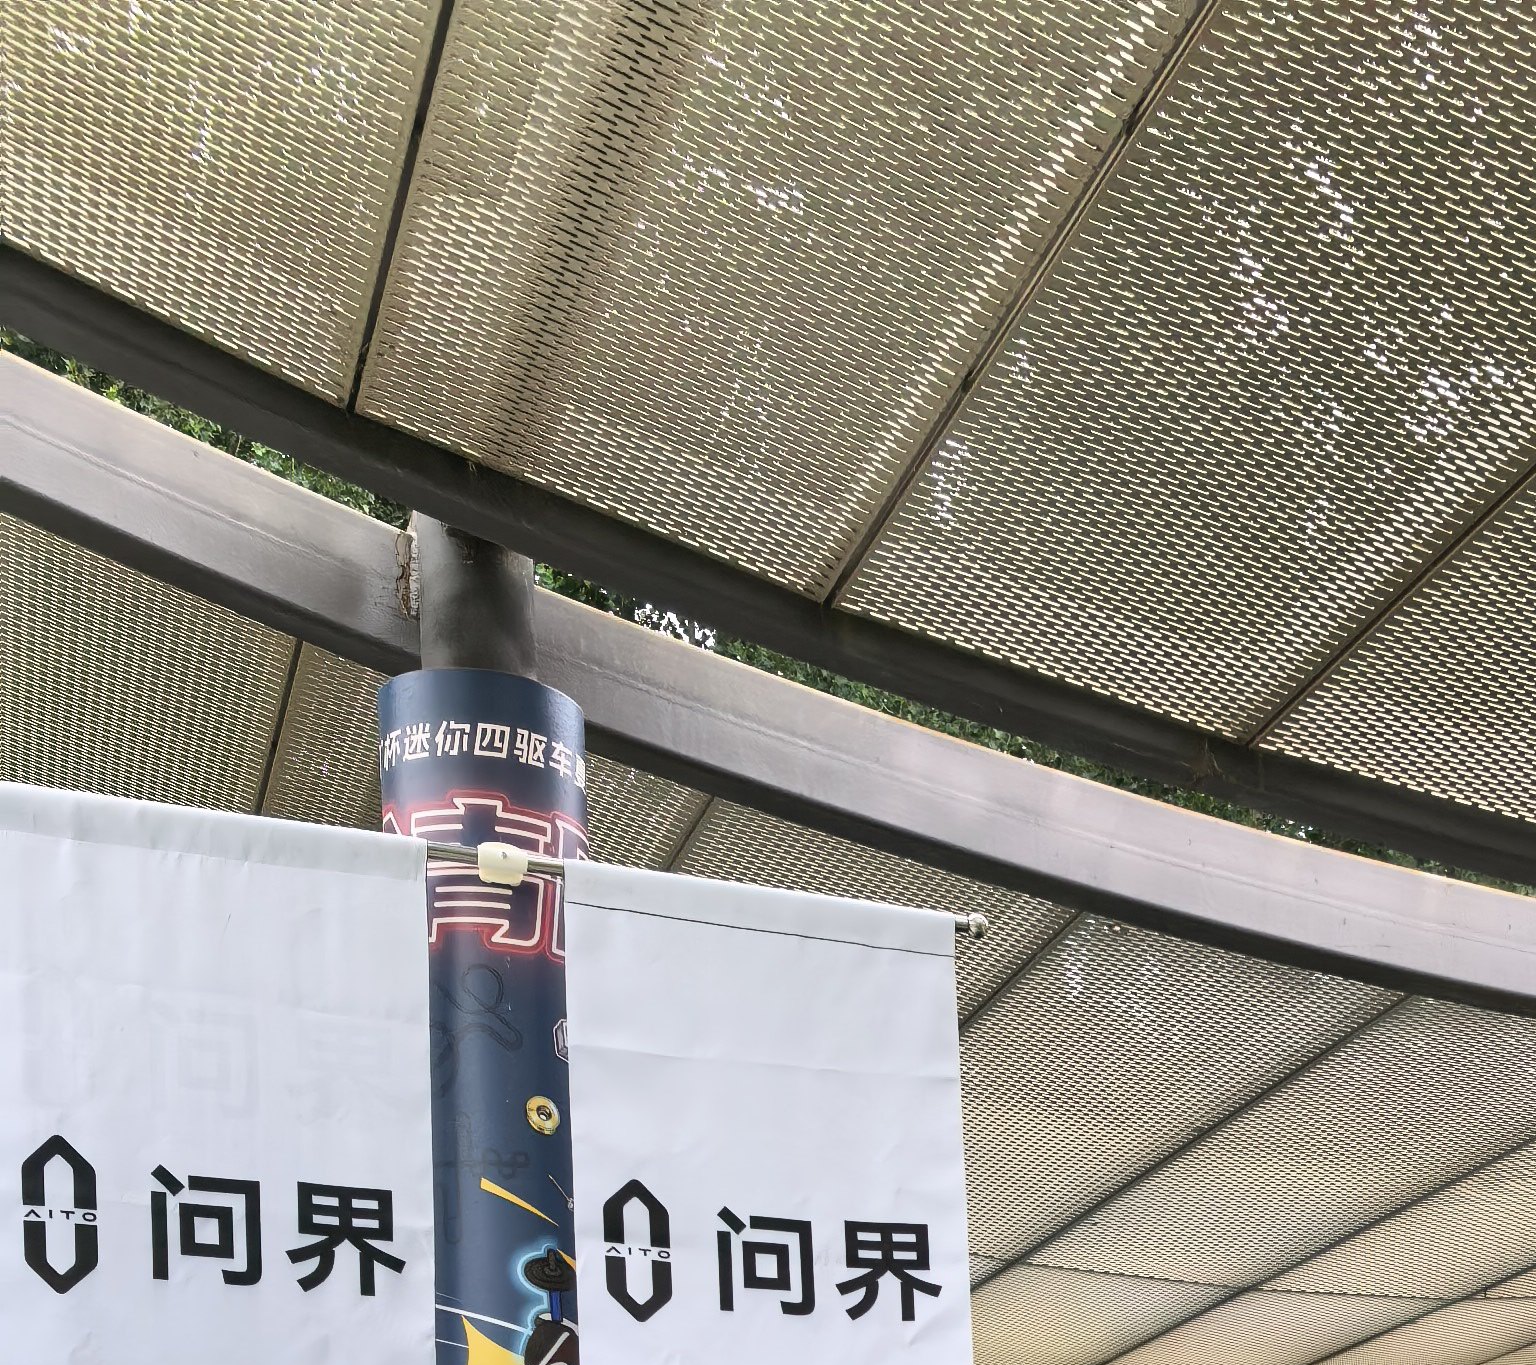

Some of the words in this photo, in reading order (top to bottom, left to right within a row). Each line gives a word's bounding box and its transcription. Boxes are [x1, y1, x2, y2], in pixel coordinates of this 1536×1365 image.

[23, 1208, 98, 1223] AITO
[150, 1163, 407, 1297] 问界
[606, 1246, 671, 1260] AITO
[716, 1205, 943, 1322] 问界
